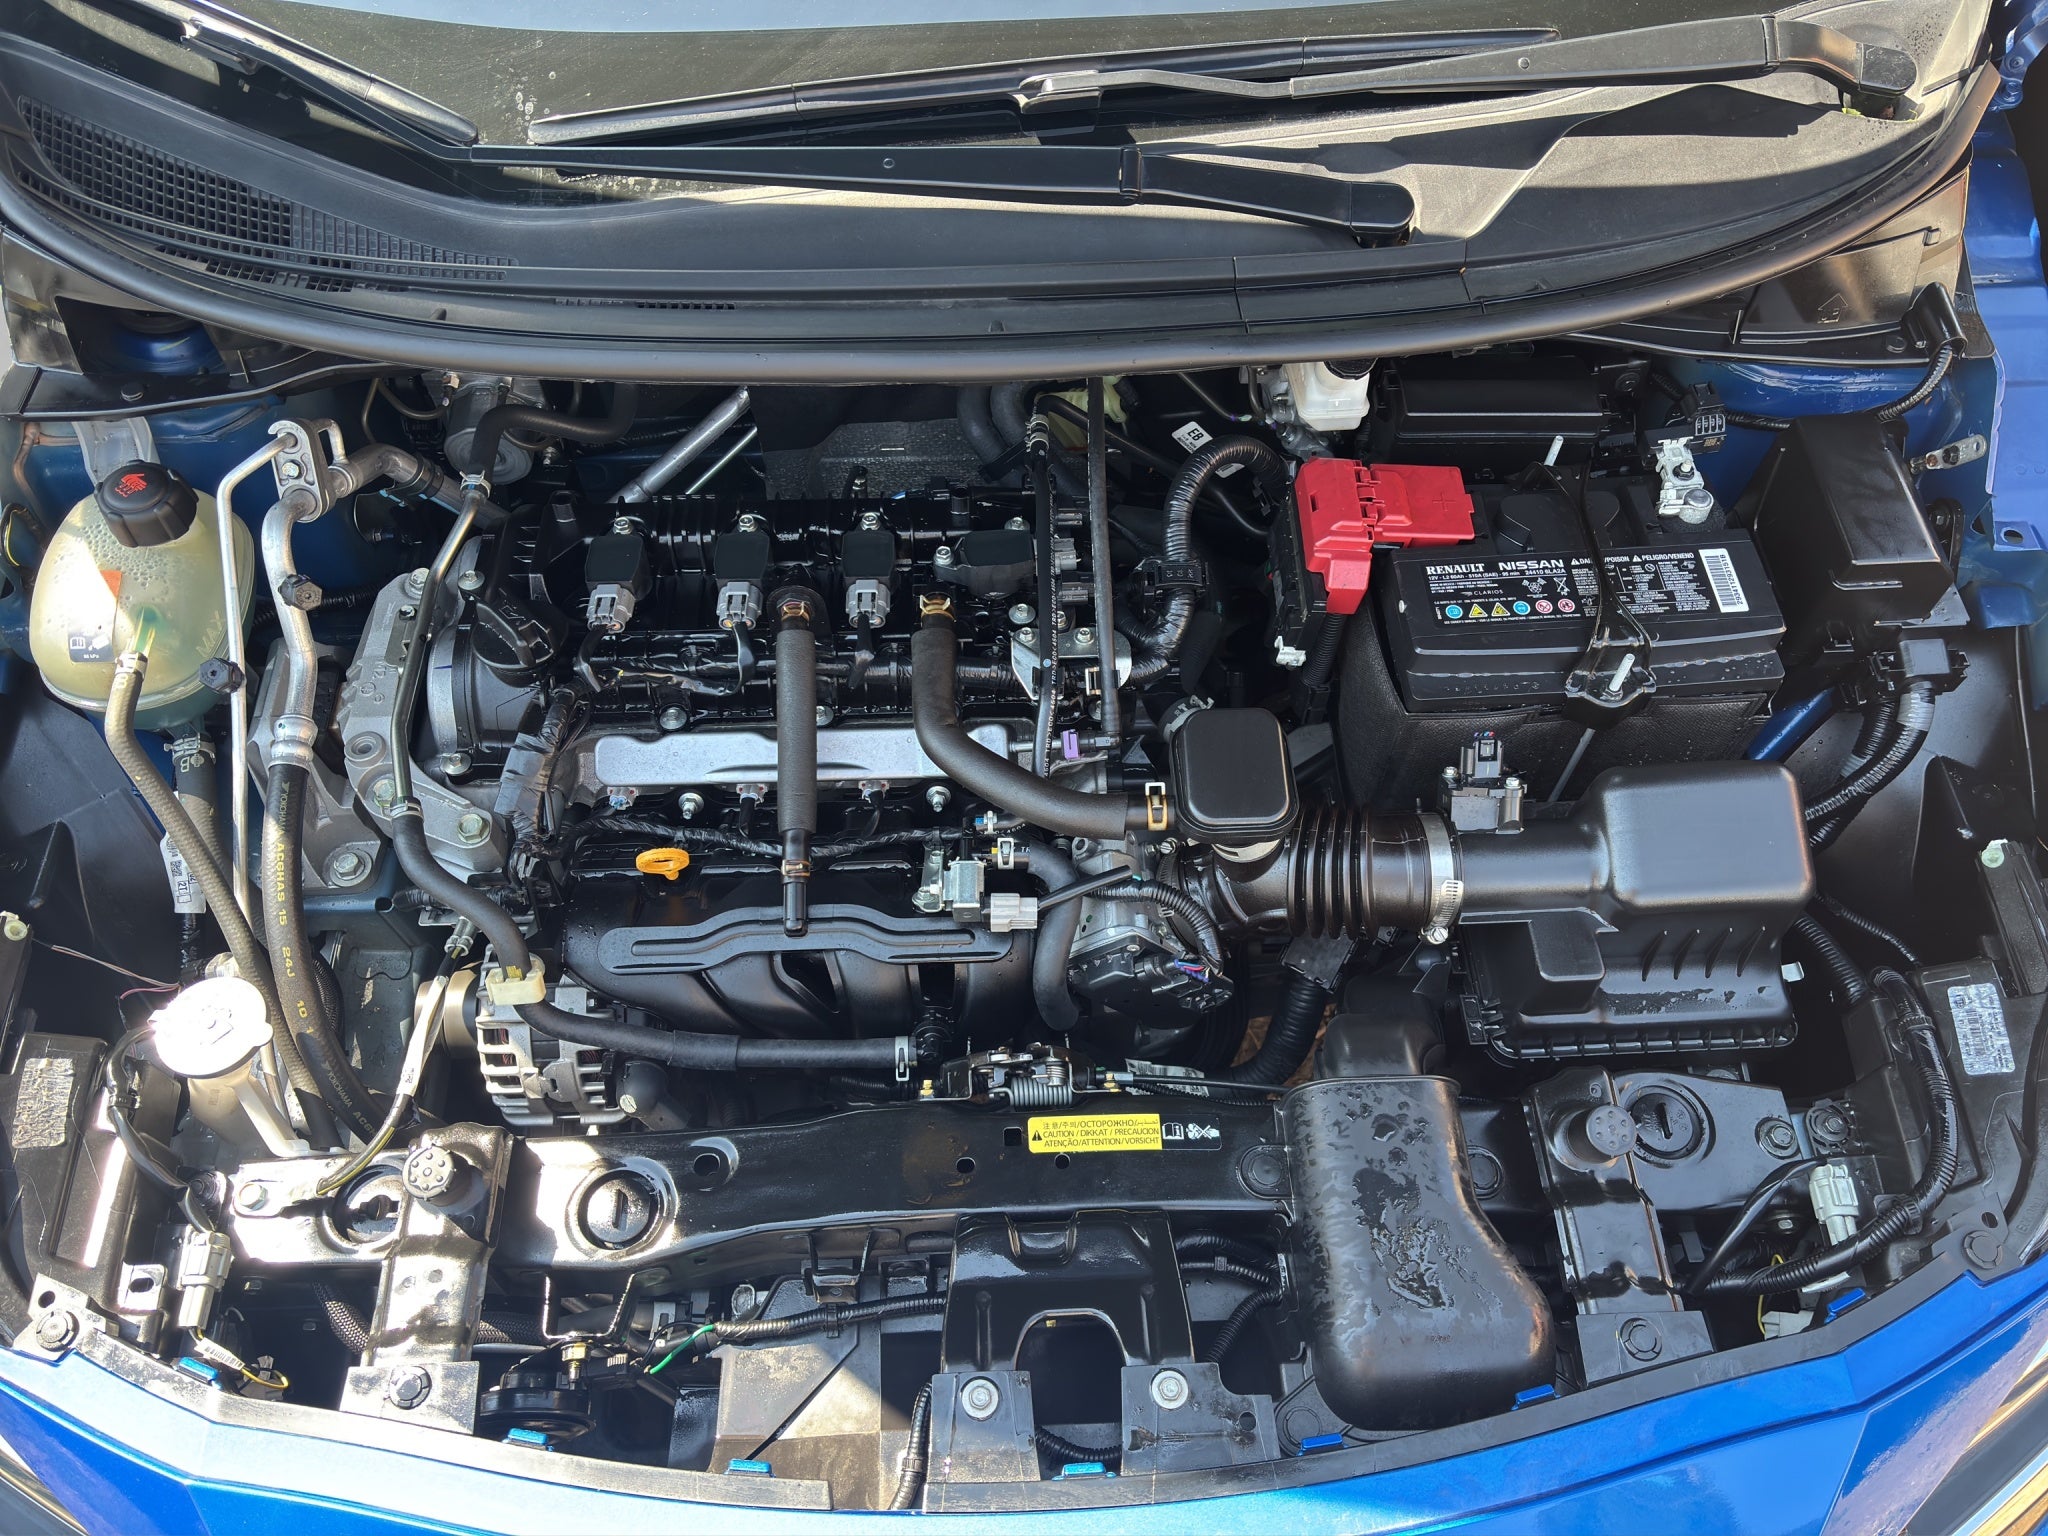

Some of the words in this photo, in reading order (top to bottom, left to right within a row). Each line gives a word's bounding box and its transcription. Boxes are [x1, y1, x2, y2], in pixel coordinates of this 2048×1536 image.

[1187, 428, 1204, 441] EB
[1426, 563, 1485, 575] RENAULT
[1498, 559, 1565, 570] NISSAN
[277, 792, 289, 836] YOKOHAMA
[278, 909, 287, 926] 15
[281, 946, 296, 978] 24J
[296, 999, 308, 1018] 10
[327, 1071, 353, 1108] YOKOHAMA
[1043, 1129, 1075, 1138] CAUTION
[1080, 1128, 1108, 1137] DIKKAT
